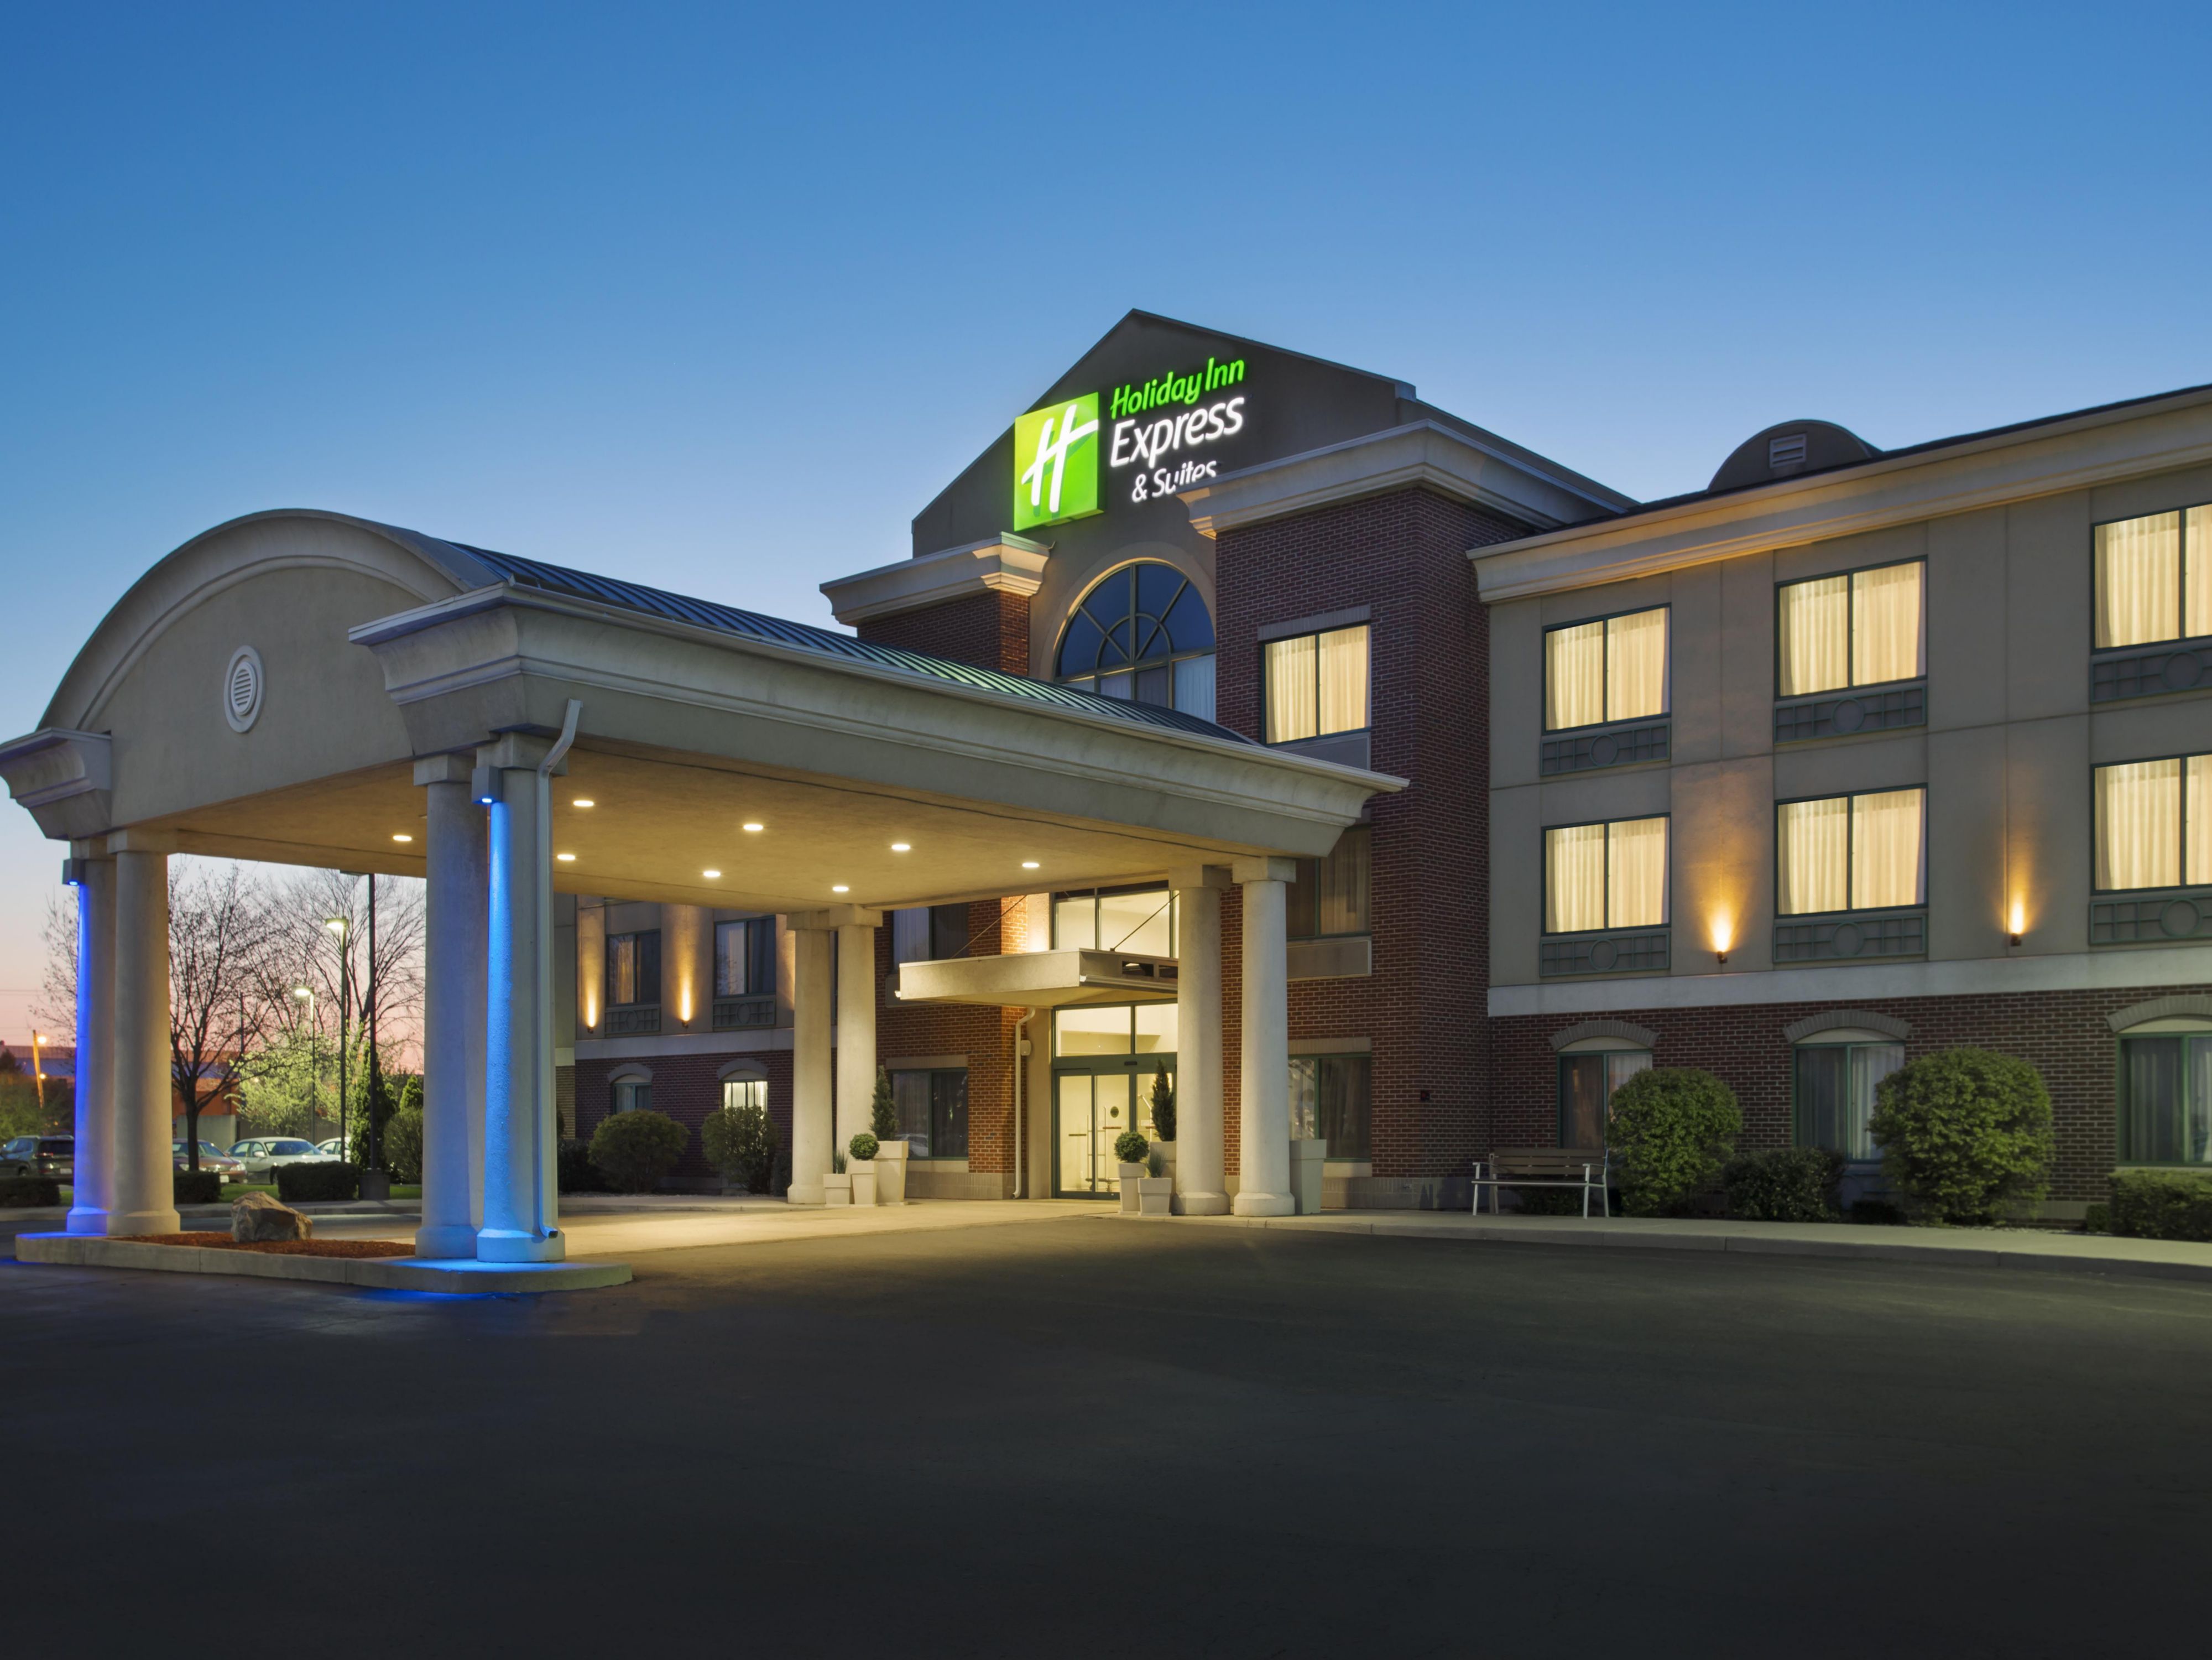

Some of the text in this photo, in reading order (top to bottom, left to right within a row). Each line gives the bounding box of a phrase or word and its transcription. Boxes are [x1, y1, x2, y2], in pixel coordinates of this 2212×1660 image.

[1109, 357, 1245, 419] Holiday Inn
[1021, 404, 1099, 513] H
[1110, 397, 1245, 469] Express
[1131, 460, 1217, 503] & Suites
